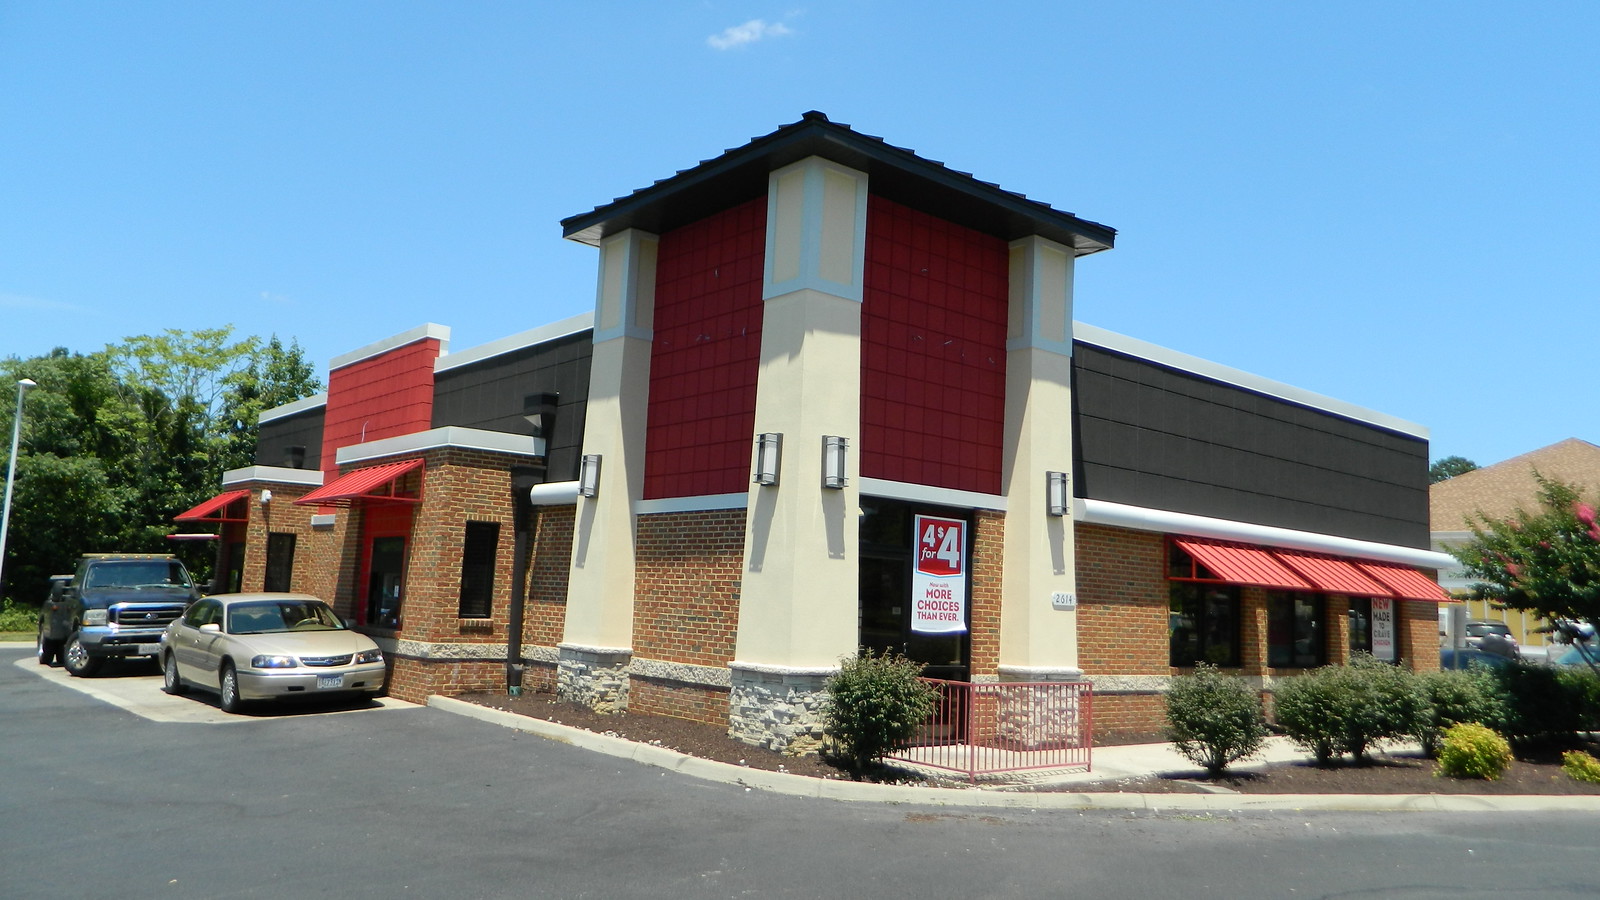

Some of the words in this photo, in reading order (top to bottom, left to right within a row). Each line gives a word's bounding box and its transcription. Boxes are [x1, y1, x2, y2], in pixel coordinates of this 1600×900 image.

[922, 524, 936, 547] 4
[921, 547, 937, 561] for
[926, 588, 952, 600] MORE
[1056, 594, 1072, 604] 2614
[917, 600, 960, 612] CHOICES
[1372, 597, 1389, 609] NEW
[917, 611, 938, 621] THAN
[939, 612, 959, 621] EVER.
[1373, 611, 1390, 622] MADE
